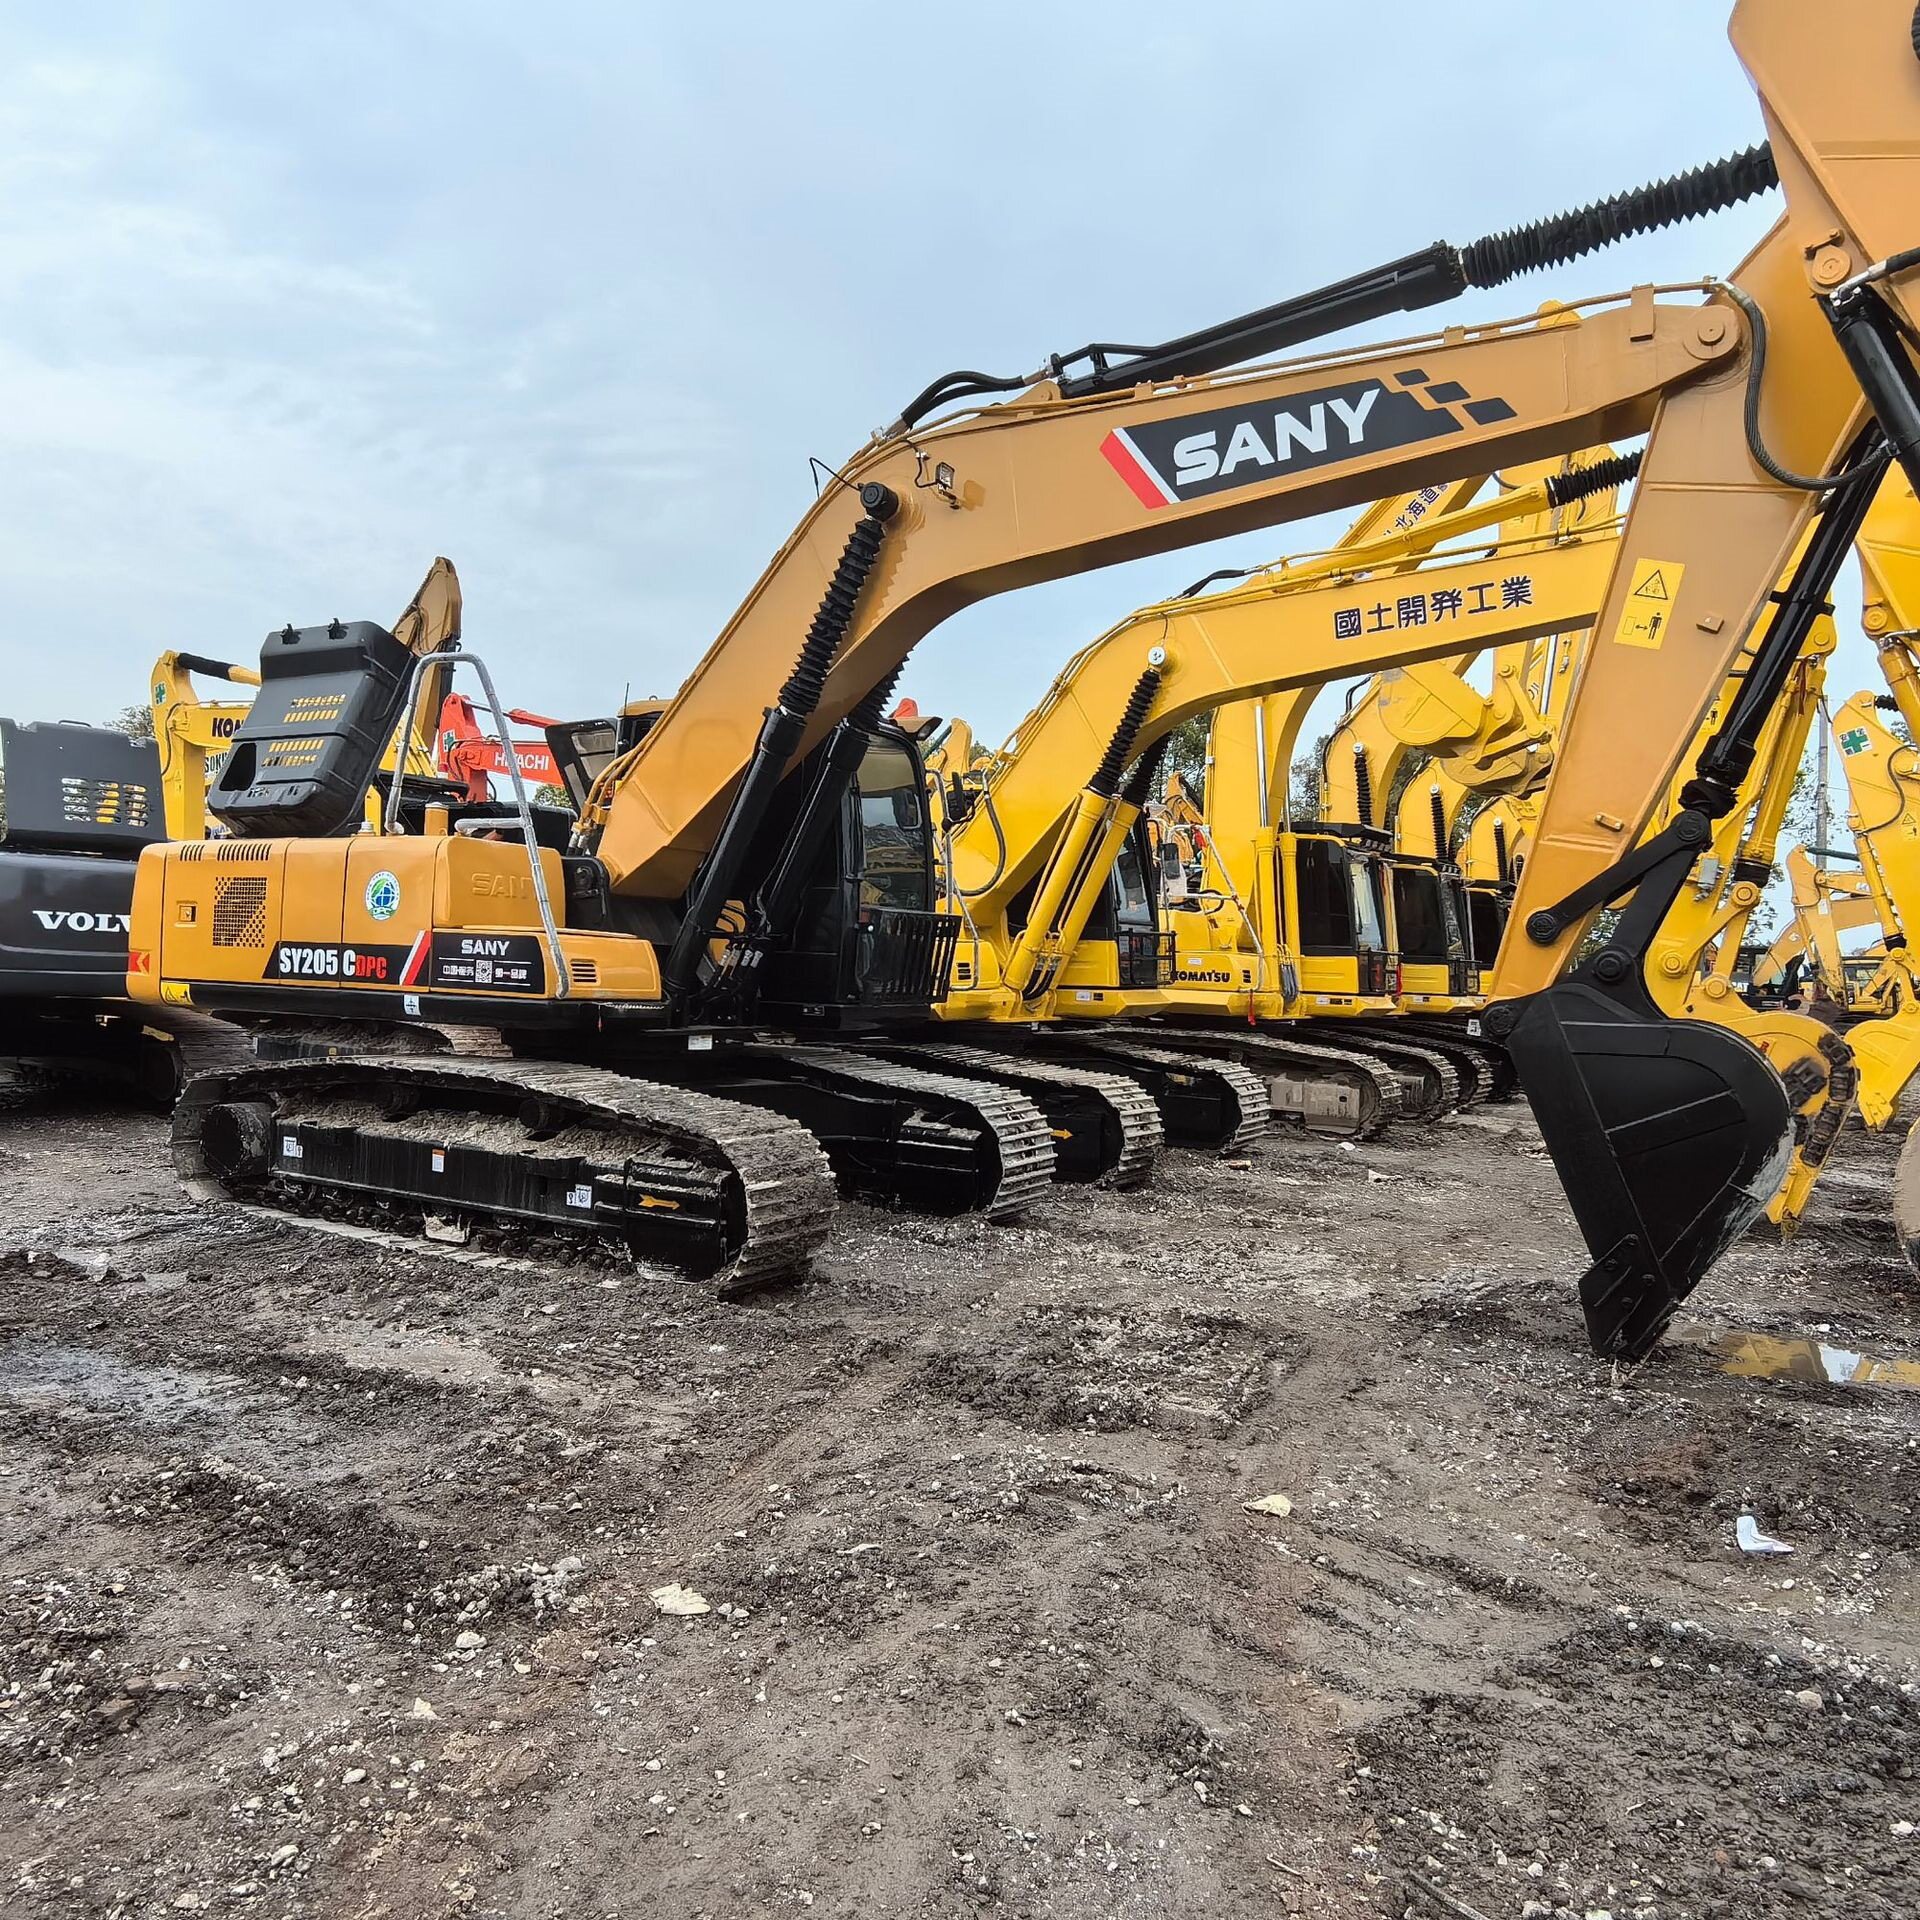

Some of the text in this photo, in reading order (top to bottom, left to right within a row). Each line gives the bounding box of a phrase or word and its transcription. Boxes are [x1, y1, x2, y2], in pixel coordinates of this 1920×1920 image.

[1173, 388, 1380, 486] SANY
[1382, 484, 1449, 536] 北海道
[471, 873, 533, 898] SAN
[461, 938, 510, 956] SANY
[279, 947, 339, 975] SY205
[1170, 969, 1231, 983] KOMATSU
